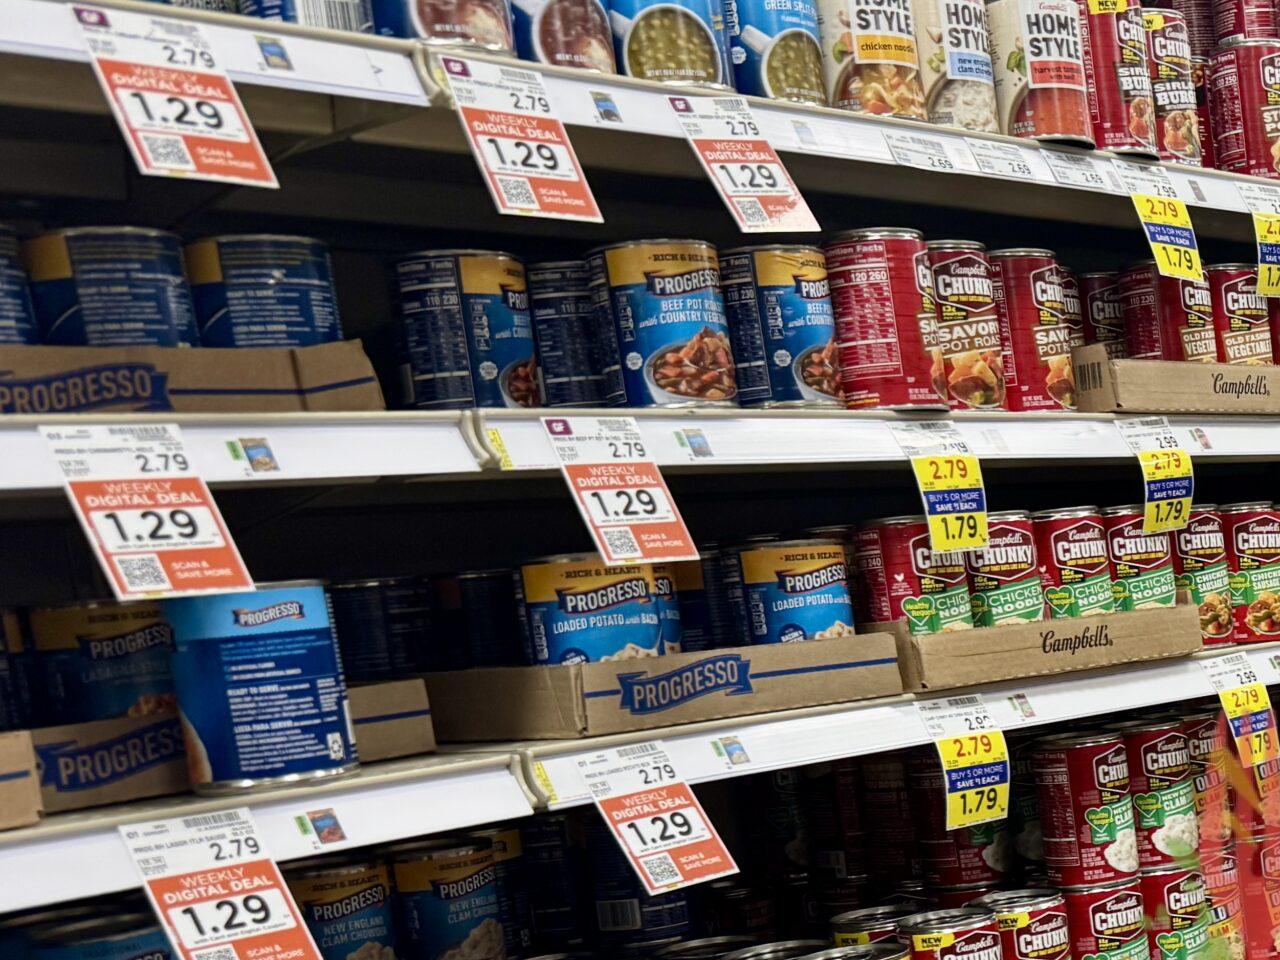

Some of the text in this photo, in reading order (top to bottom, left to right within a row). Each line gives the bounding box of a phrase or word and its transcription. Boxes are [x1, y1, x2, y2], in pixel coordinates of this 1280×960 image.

[1027, 12, 1077, 36] HOME
[162, 45, 215, 68] 2.79
[861, 41, 892, 53] chicken
[1029, 36, 1080, 59] STYLE
[129, 92, 224, 129] 1.29
[514, 94, 550, 114] 2.79
[726, 121, 760, 136] 2.79
[486, 138, 559, 170] 1.29
[718, 164, 778, 188] 1.29
[1146, 199, 1179, 218] 2.79
[1161, 246, 1194, 270] 1.79
[1211, 373, 1270, 399] Campbell's
[608, 442, 646, 459] 2.79
[135, 454, 189, 473] 2.79
[929, 460, 968, 479] 2.79
[591, 491, 658, 517] 1.29
[105, 510, 198, 542] 1.29
[941, 516, 977, 539] 1.79
[567, 580, 647, 612] PROGRESSO
[239, 603, 300, 626] PROGRESSO
[553, 614, 625, 634] LOADED POTATO
[1040, 625, 1114, 654] Campbell's
[634, 662, 739, 710] PROGRESSO
[952, 736, 993, 758] 2.79
[638, 764, 676, 785] 2.79
[951, 771, 968, 781] BUY
[977, 768, 988, 778] OR
[989, 765, 1005, 776] MORE
[957, 779, 973, 788] SAVE
[980, 775, 998, 785] EACH
[959, 789, 998, 815] 1.79
[628, 811, 693, 846] 1.29
[209, 837, 260, 861] 2.79
[181, 868, 245, 887] WEEKLY
[164, 876, 273, 904] DIGITAL DEAL
[182, 894, 271, 936] 1.29
[921, 937, 942, 946] NEW
